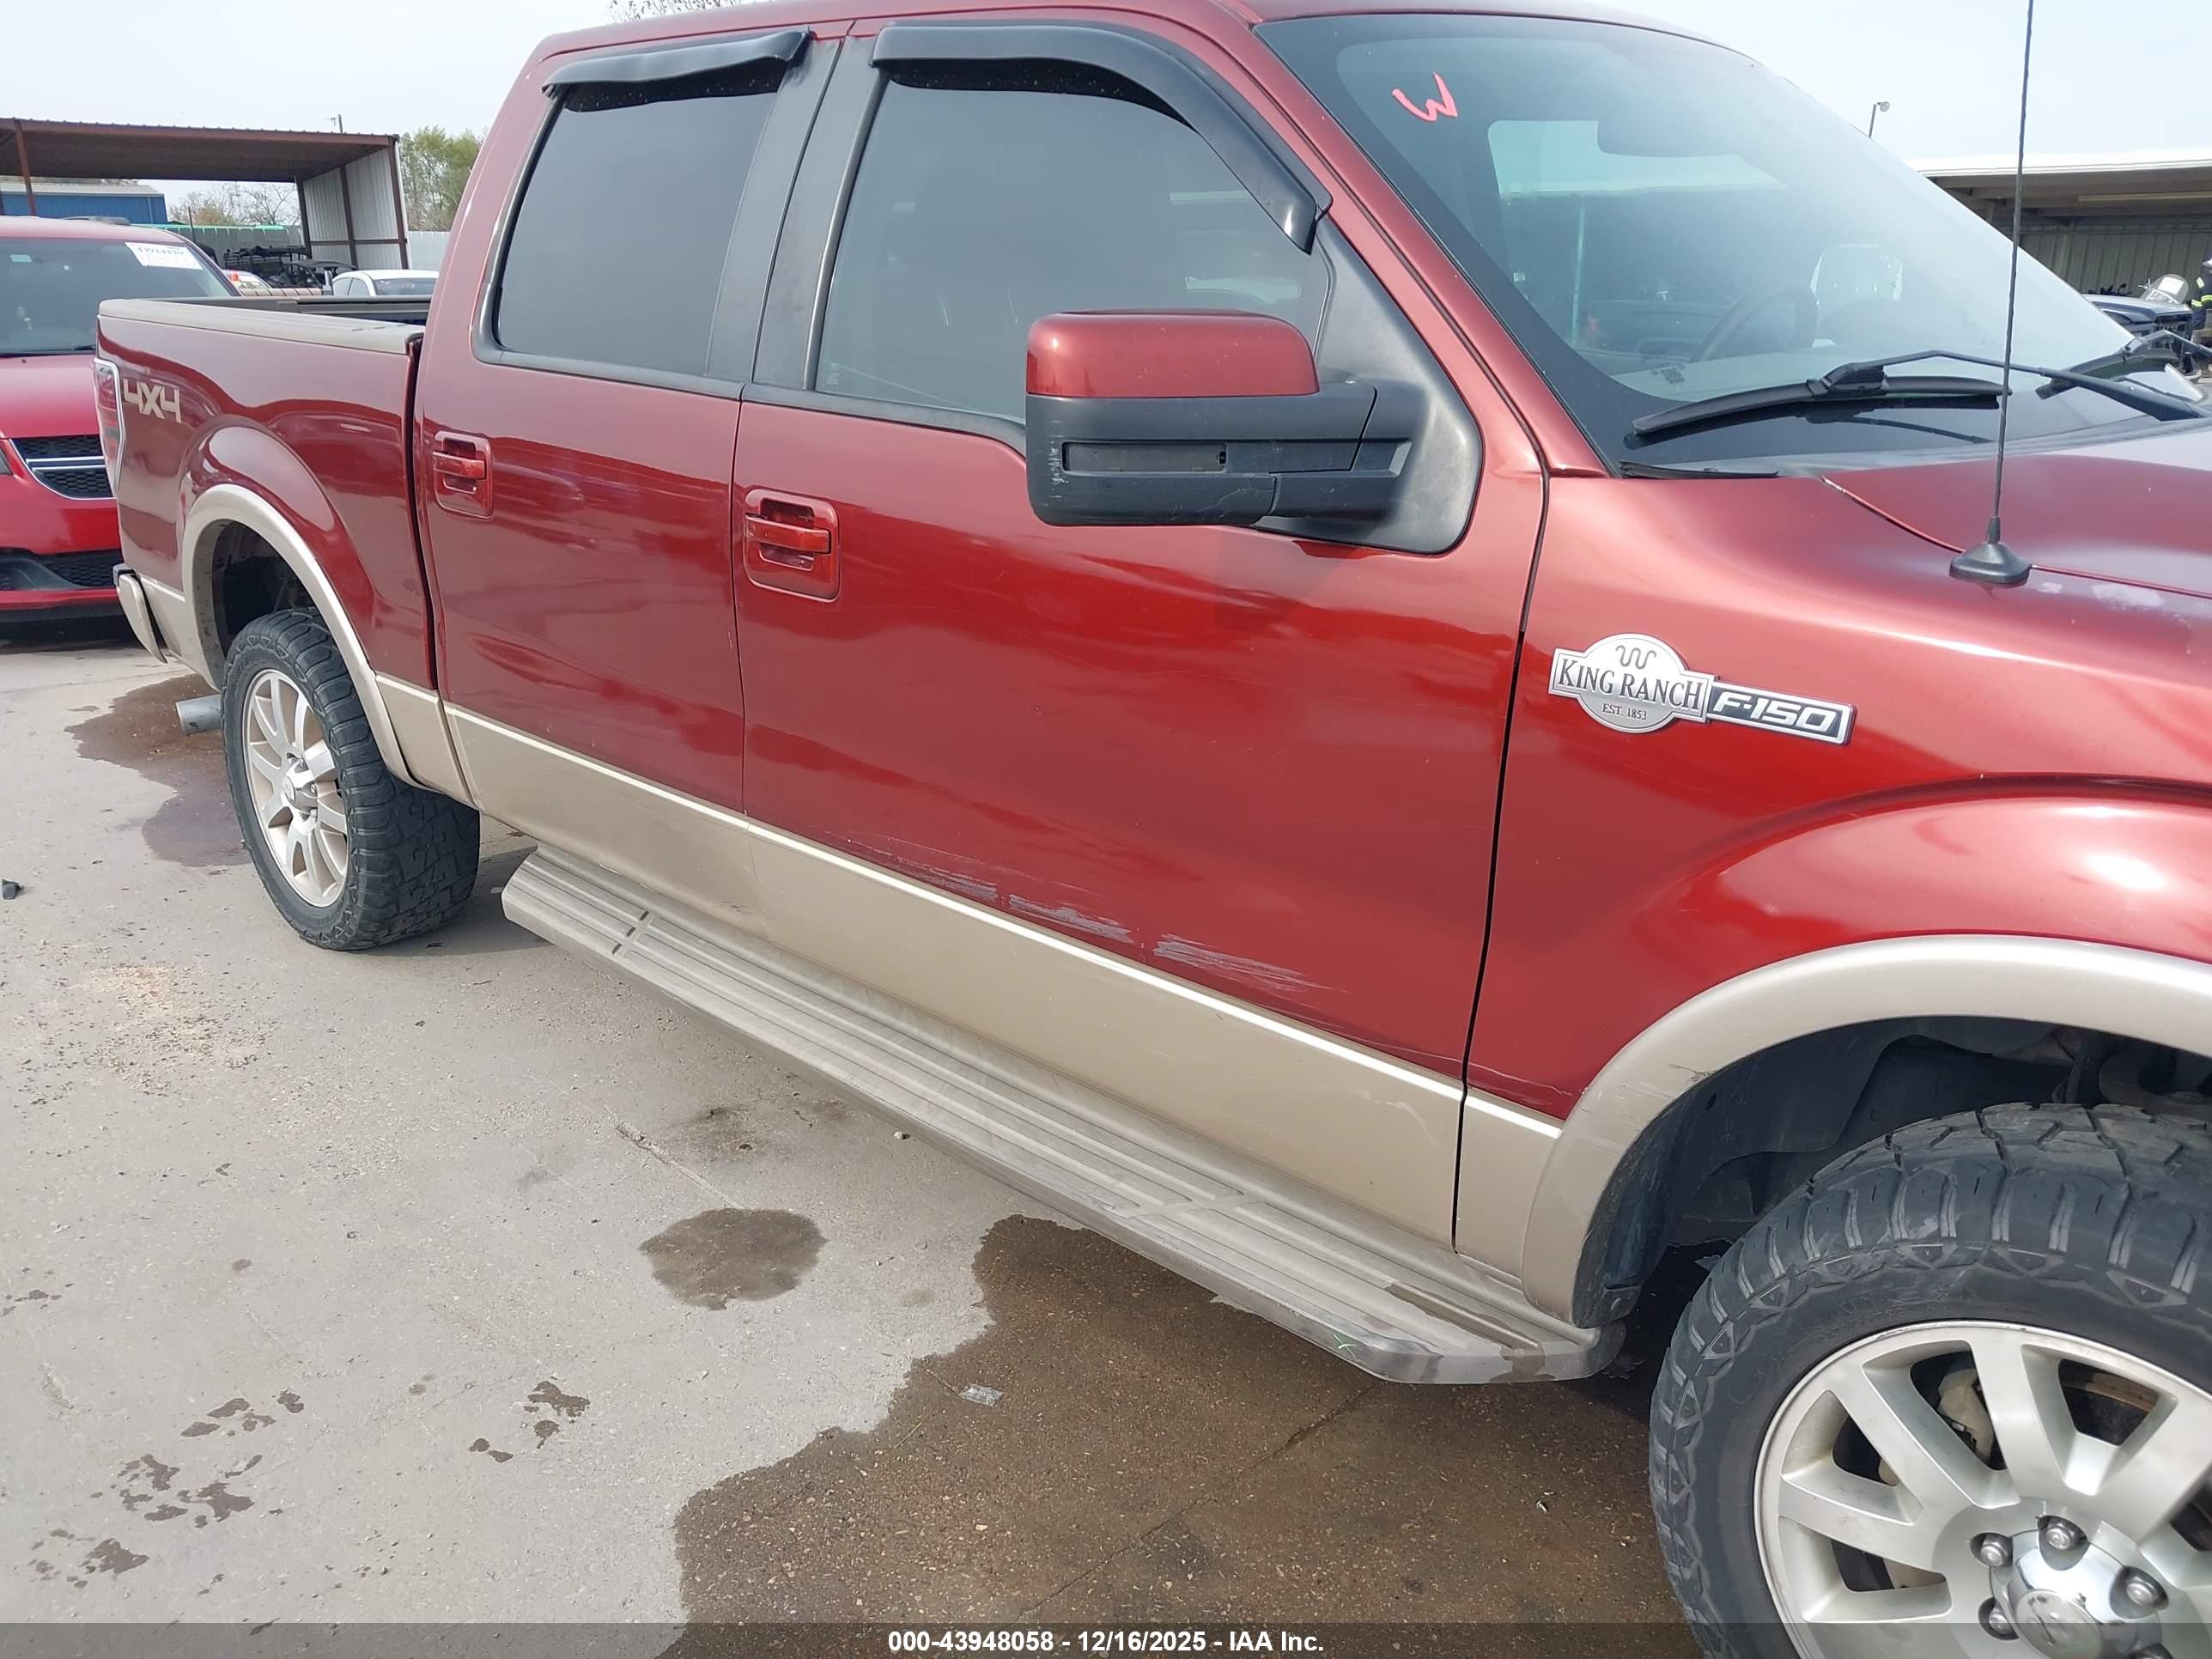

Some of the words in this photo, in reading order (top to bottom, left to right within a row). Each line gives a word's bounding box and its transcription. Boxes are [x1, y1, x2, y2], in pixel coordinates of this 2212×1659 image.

[1557, 658, 1615, 696] KING
[1620, 675, 1705, 712] RANCH
[1601, 703, 1624, 718] EST.
[1626, 707, 1648, 721] 1853
[1712, 690, 1838, 733] F-150
